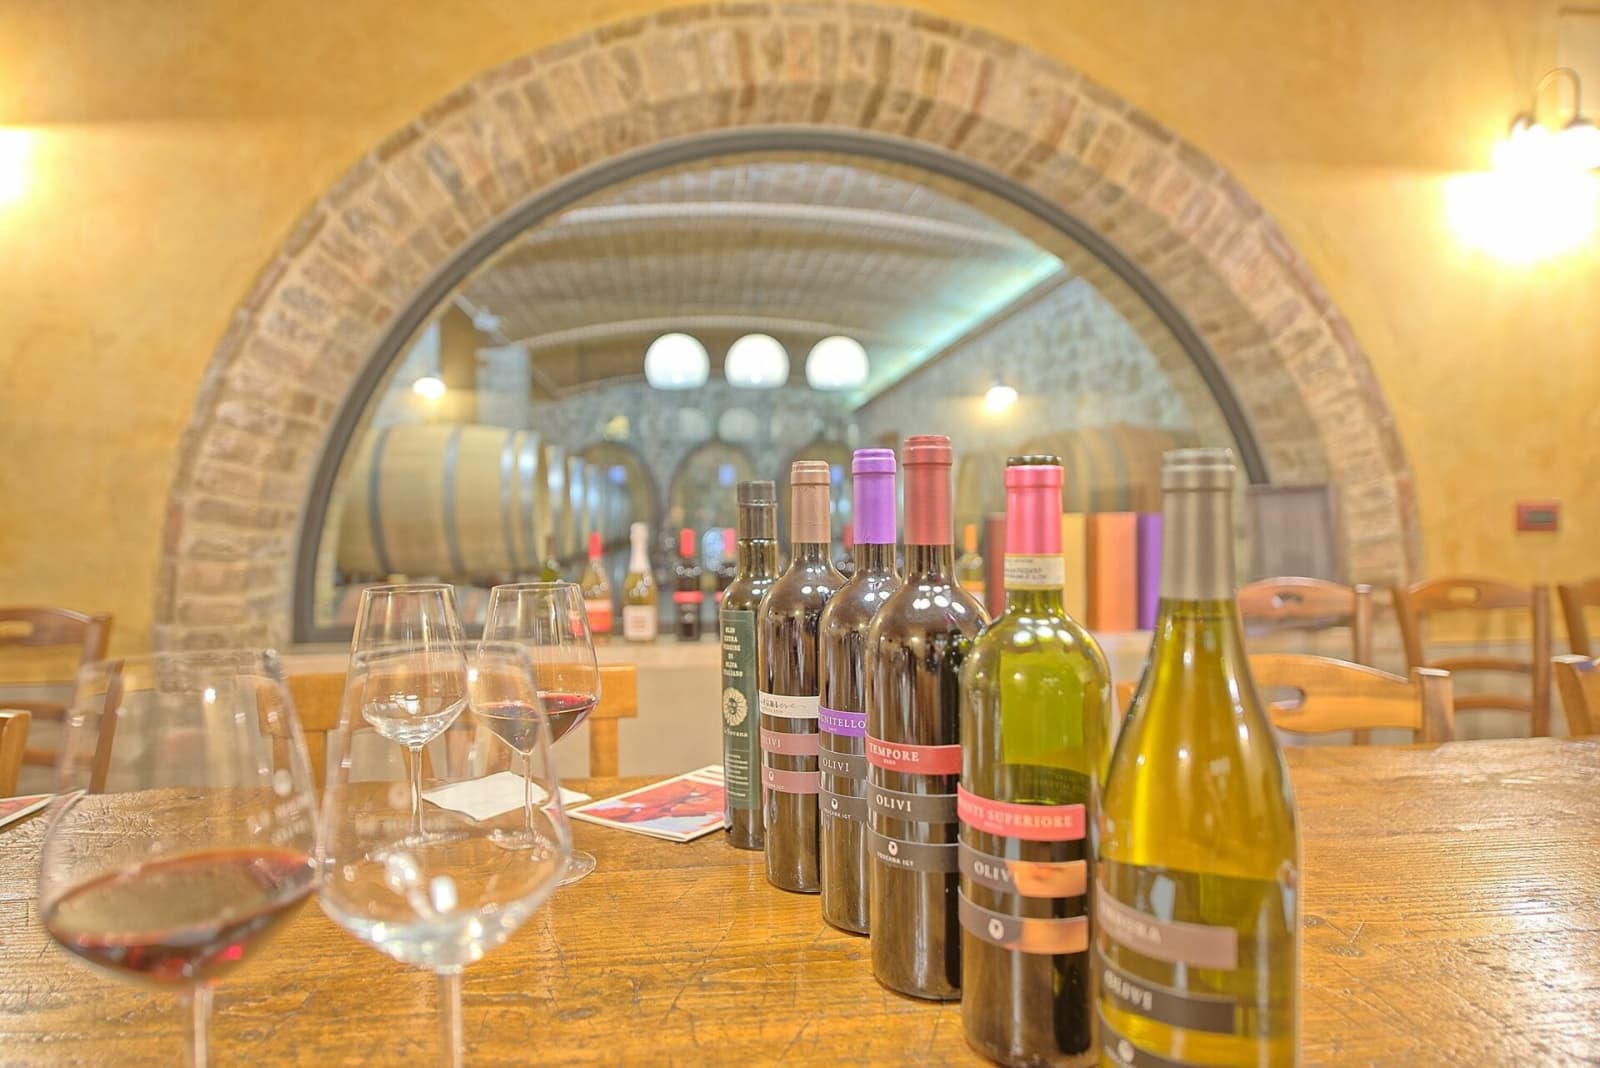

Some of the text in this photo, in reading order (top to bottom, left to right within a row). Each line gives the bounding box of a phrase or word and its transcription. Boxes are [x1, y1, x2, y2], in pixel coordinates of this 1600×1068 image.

[868, 742, 920, 762] TEMPORE
[822, 757, 850, 773] OLIVI
[876, 794, 912, 813] OLIVI
[987, 810, 1073, 829] SUPERIORE
